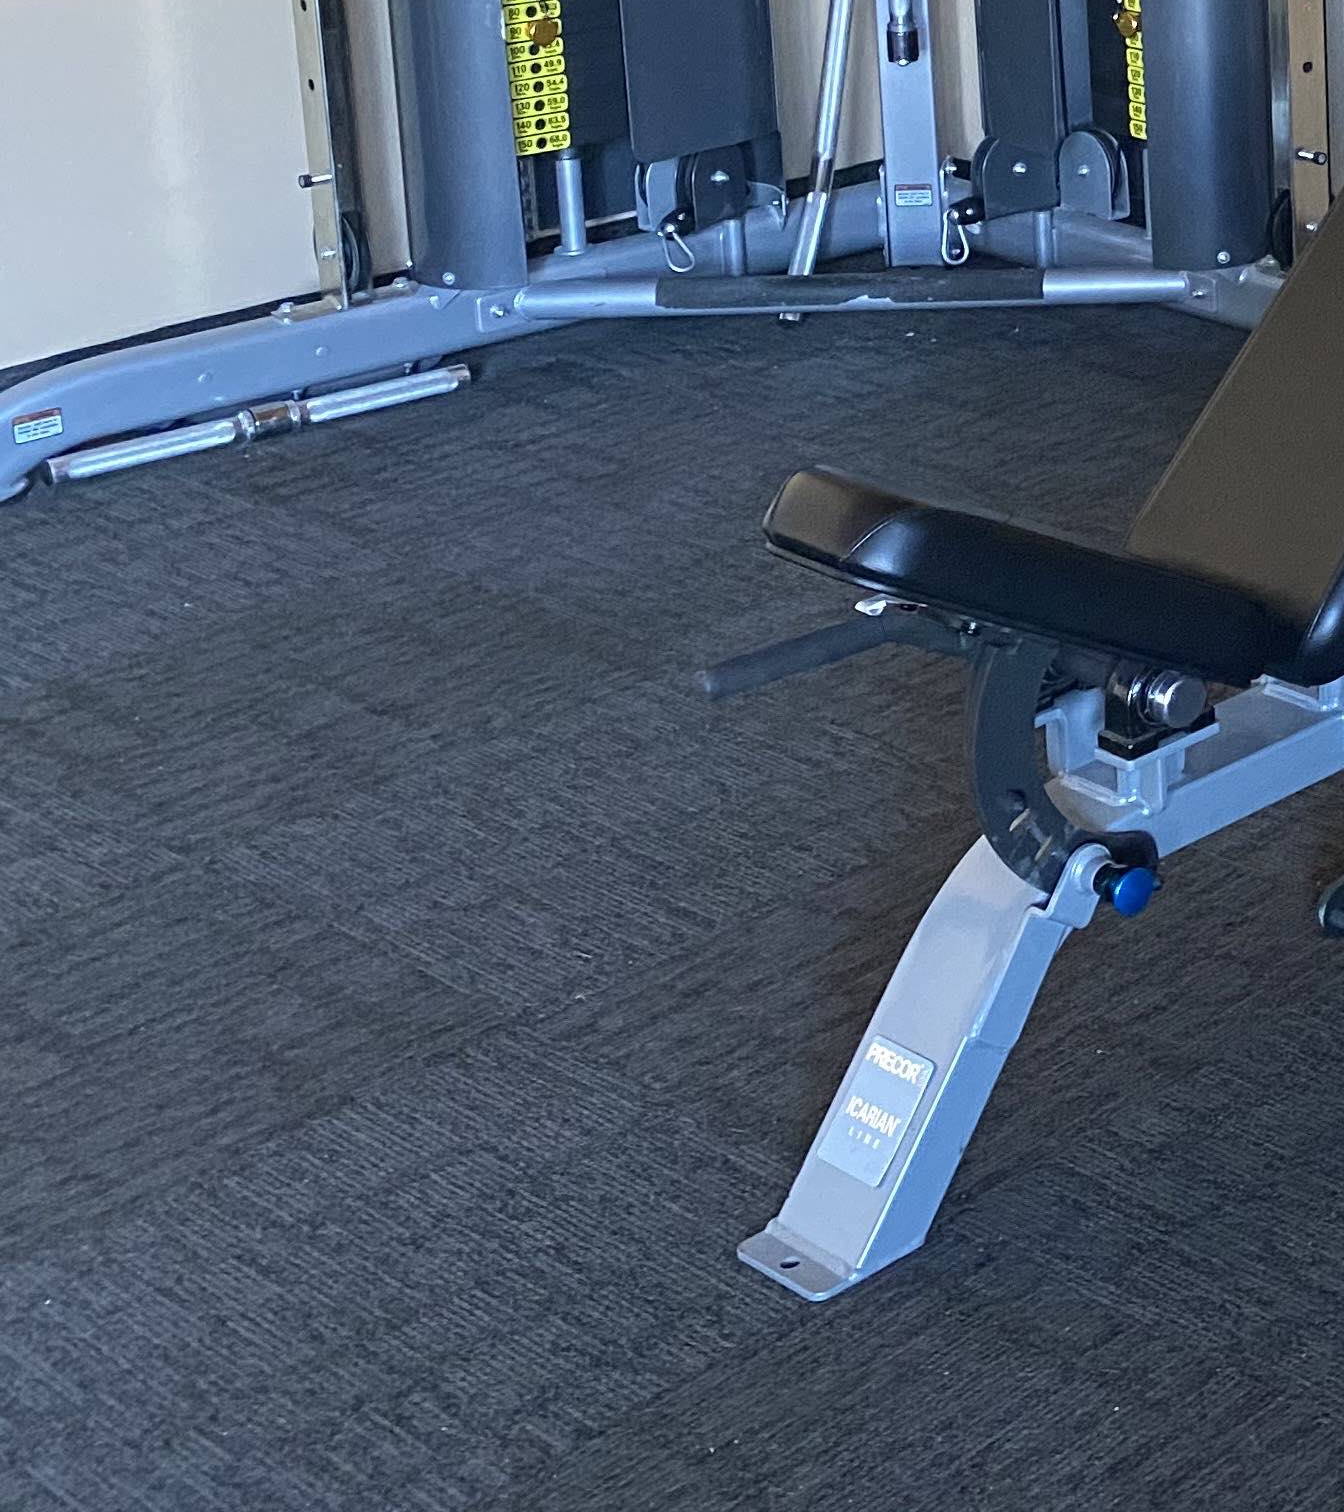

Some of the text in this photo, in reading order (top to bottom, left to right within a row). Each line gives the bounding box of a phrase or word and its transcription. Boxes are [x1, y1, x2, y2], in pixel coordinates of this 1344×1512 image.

[510, 45, 525, 55] 100
[511, 64, 526, 75] 110
[514, 77, 564, 93] 120 54.4
[515, 95, 565, 112] 130 59.0
[516, 120, 532, 130] 140
[517, 139, 533, 150] 150
[864, 1042, 919, 1085] PRECOR
[845, 1095, 901, 1137] ICARIAN
